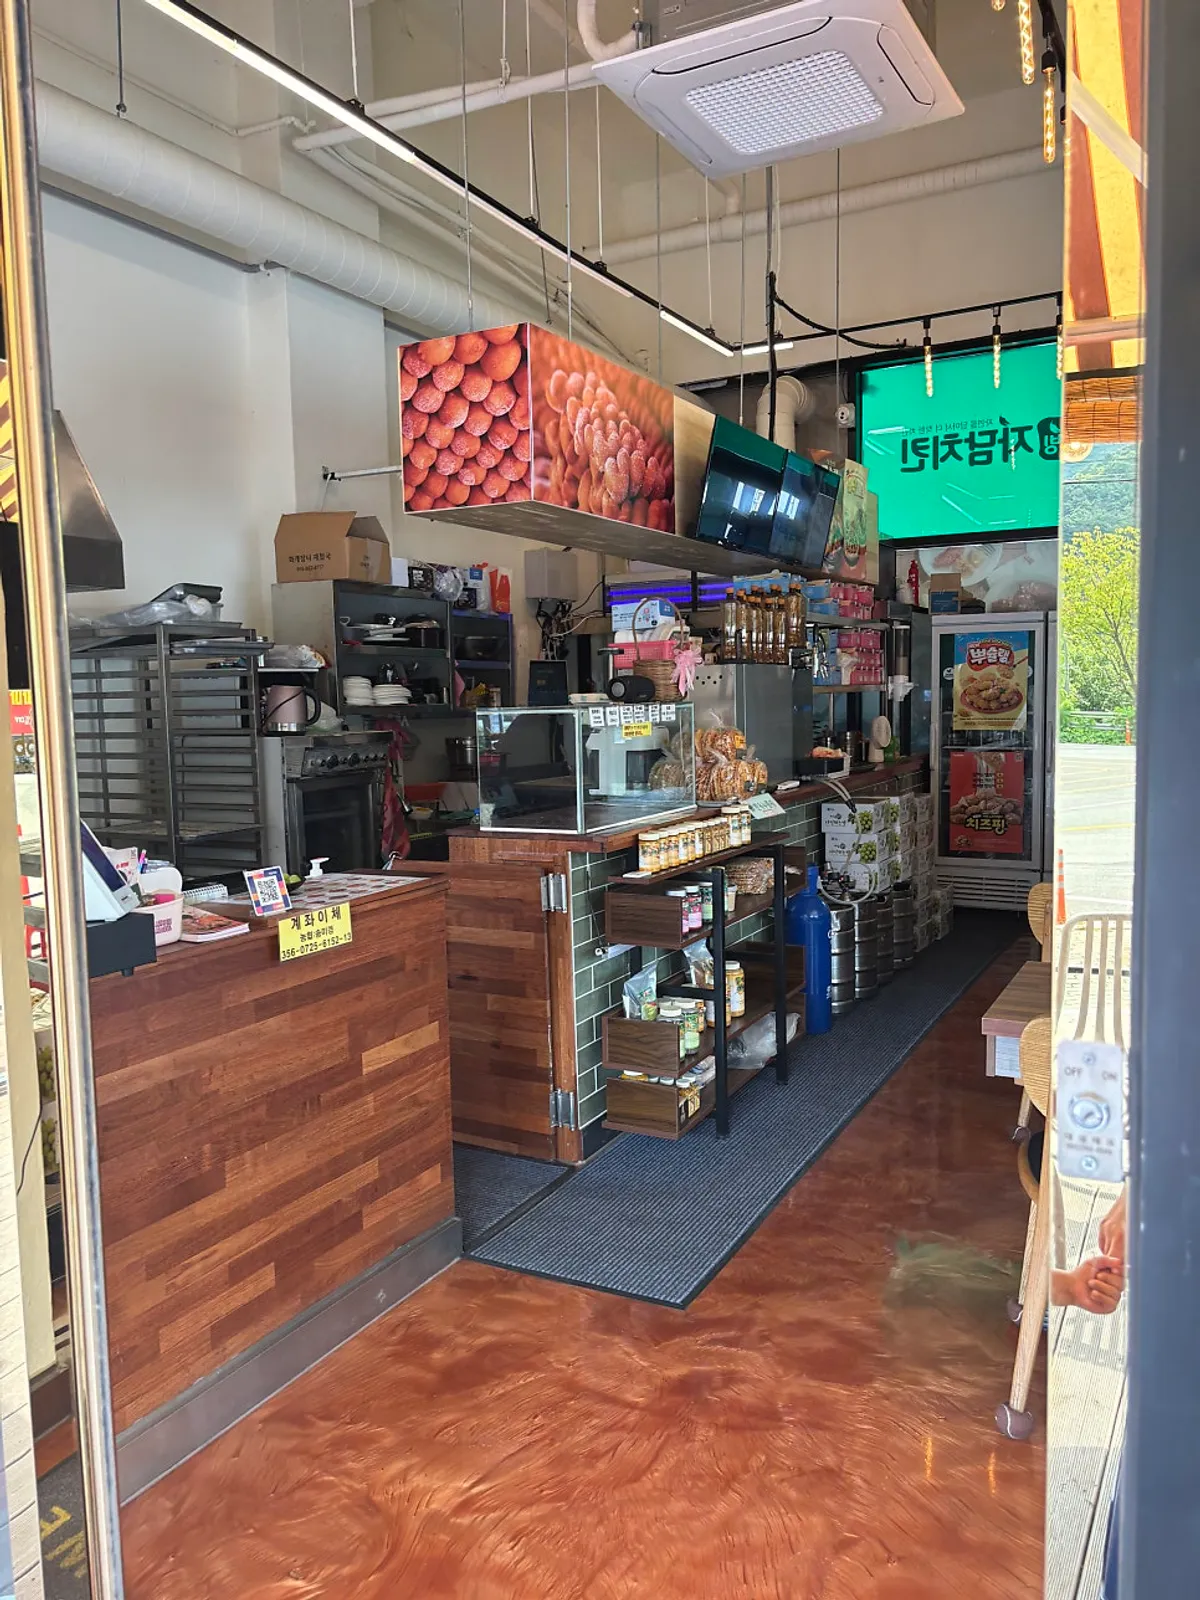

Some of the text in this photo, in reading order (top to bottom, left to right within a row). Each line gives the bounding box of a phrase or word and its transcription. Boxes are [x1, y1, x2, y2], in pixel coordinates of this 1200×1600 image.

[965, 817, 1005, 835] 치즈핑
[281, 931, 352, 959] 356-0725-6152-13
[1064, 1066, 1117, 1081] OFF ON
